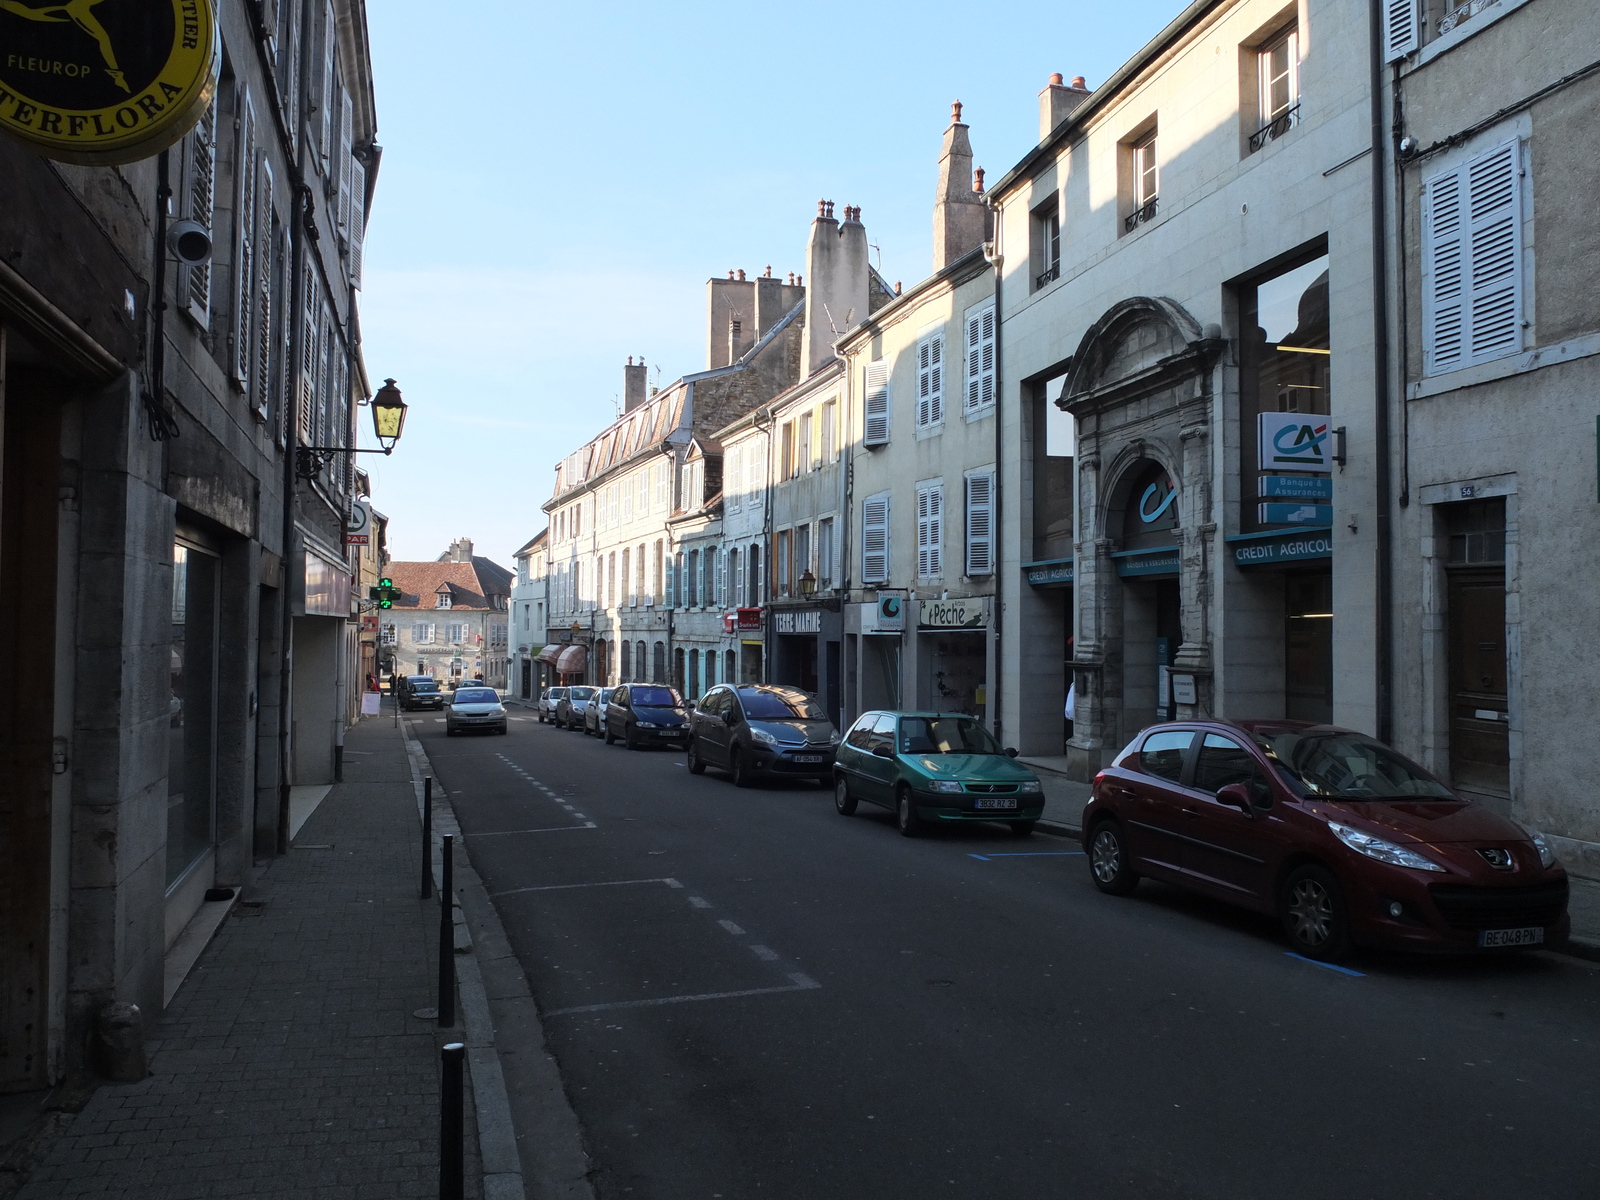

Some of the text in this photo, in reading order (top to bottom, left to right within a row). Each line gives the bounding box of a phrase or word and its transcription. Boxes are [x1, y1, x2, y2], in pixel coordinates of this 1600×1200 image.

[181, 0, 198, 49] TIER
[7, 54, 91, 78] FLEUROP
[1274, 488, 1327, 497] Assurances
[1280, 478, 1314, 487] Banque
[1462, 487, 1471, 496] 56
[795, 611, 821, 633] MARINE
[934, 602, 965, 625] Pêche
[1485, 928, 1536, 946] BE-048-PN
